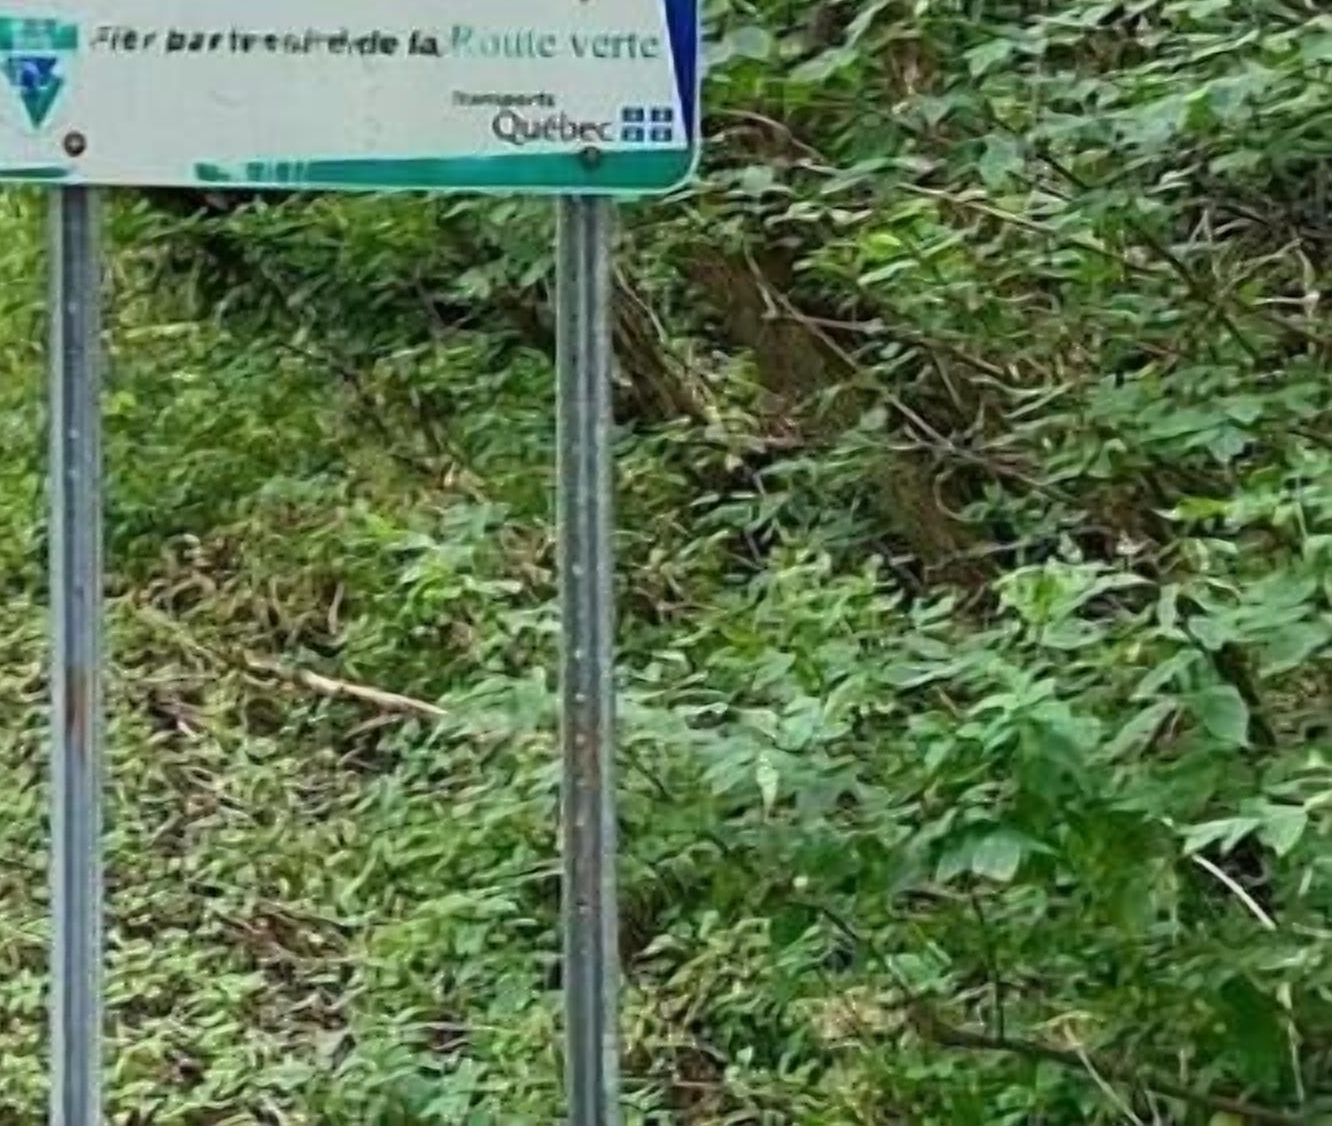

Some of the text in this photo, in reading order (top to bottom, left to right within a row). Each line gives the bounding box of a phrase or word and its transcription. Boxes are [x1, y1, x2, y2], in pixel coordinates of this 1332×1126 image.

[406, 29, 442, 57] la
[450, 24, 557, 58] Route
[570, 30, 663, 58] verte
[491, 110, 614, 146] Québec
